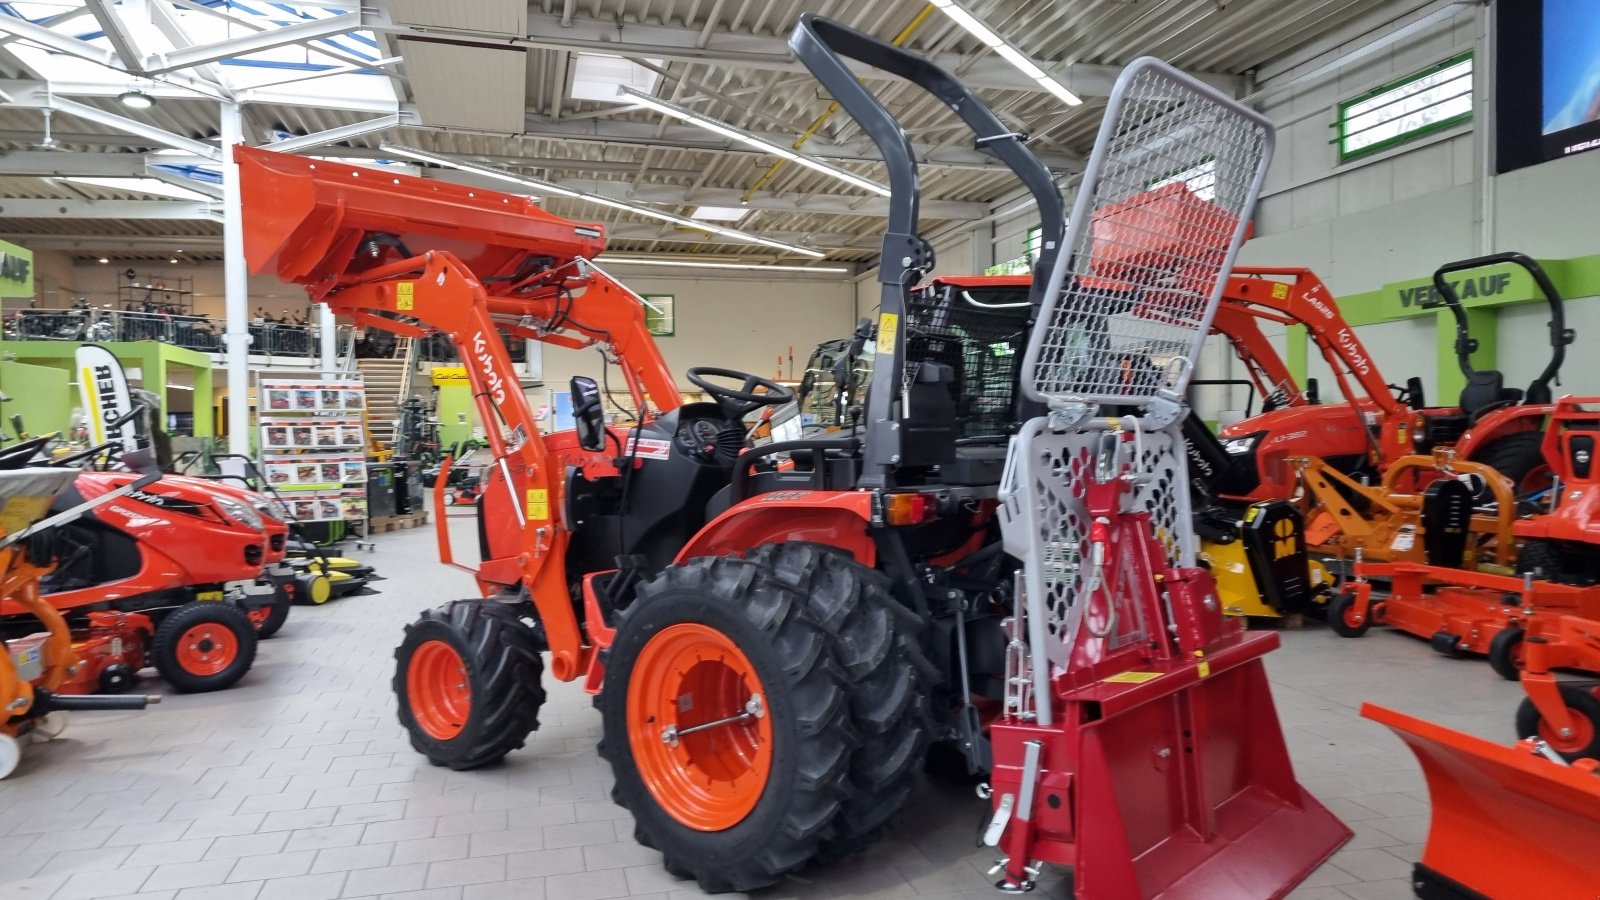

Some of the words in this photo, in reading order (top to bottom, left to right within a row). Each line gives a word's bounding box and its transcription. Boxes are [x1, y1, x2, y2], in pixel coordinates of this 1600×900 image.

[473, 331, 506, 405] Kubota
[1337, 328, 1370, 376] Kubota
[94, 364, 127, 470] RCHER
